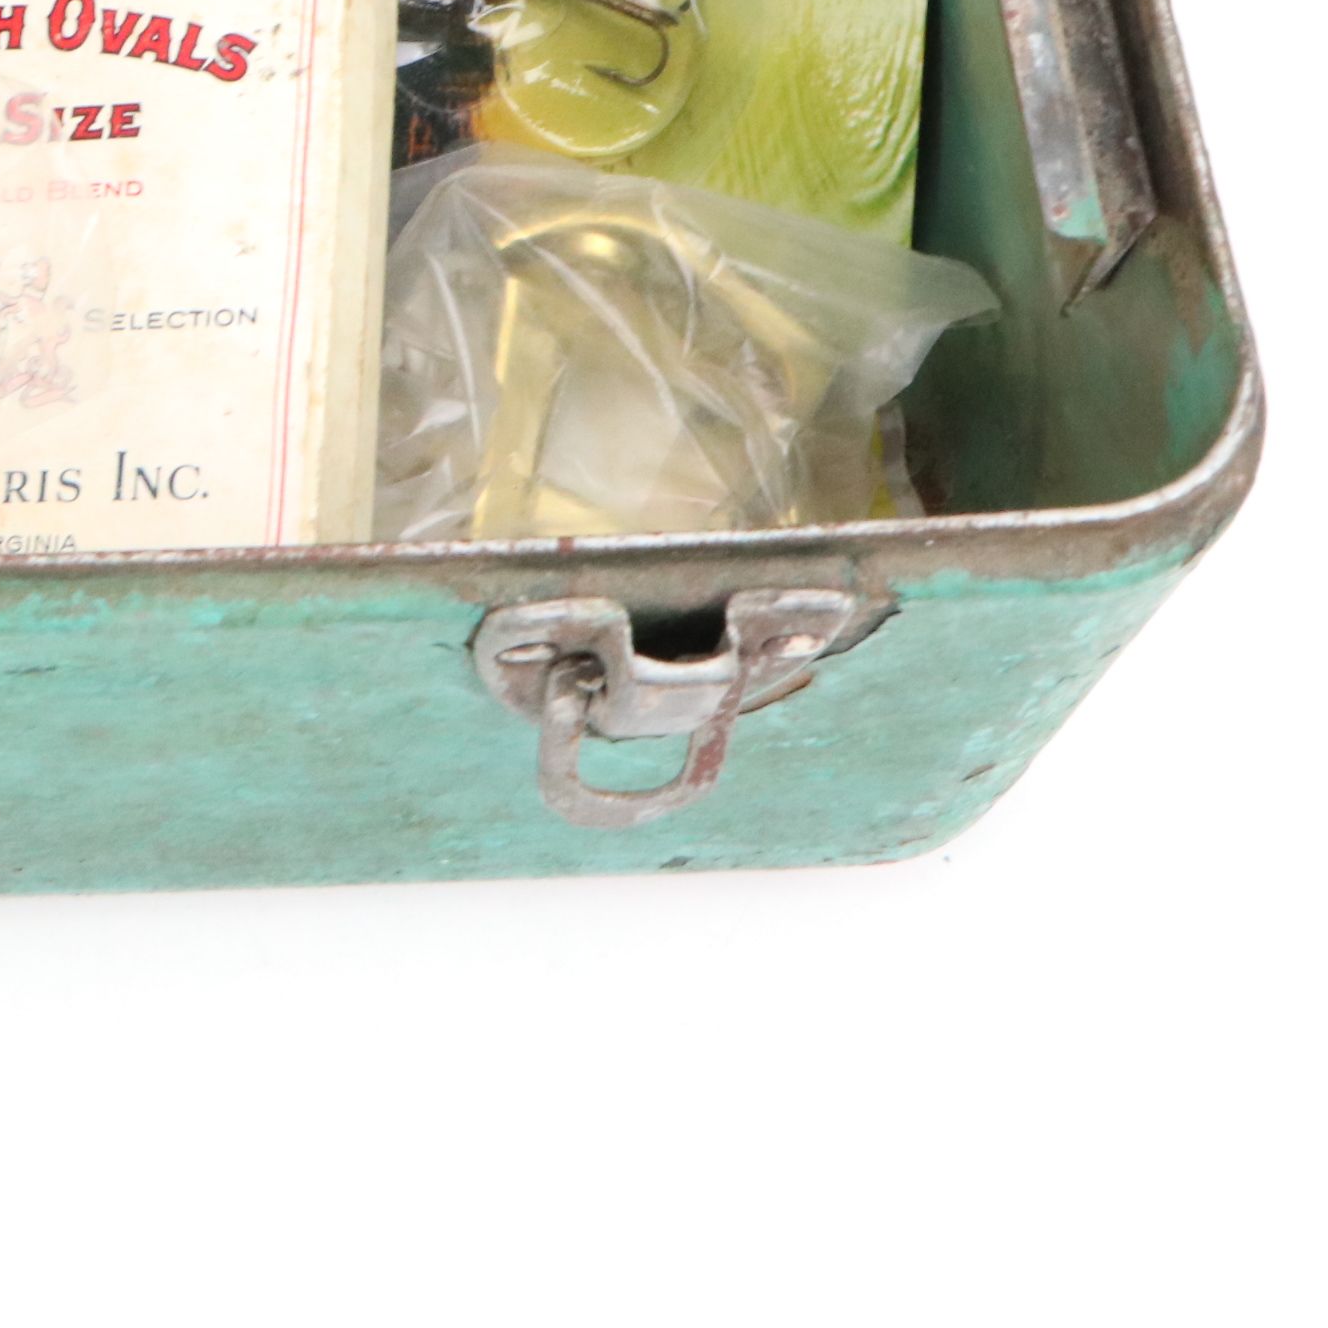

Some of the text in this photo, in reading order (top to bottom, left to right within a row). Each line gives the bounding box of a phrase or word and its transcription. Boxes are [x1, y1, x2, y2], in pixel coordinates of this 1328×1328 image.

[0, 91, 143, 145] SIZE
[82, 307, 259, 334] SELECTION
[112, 449, 210, 503] INC.
